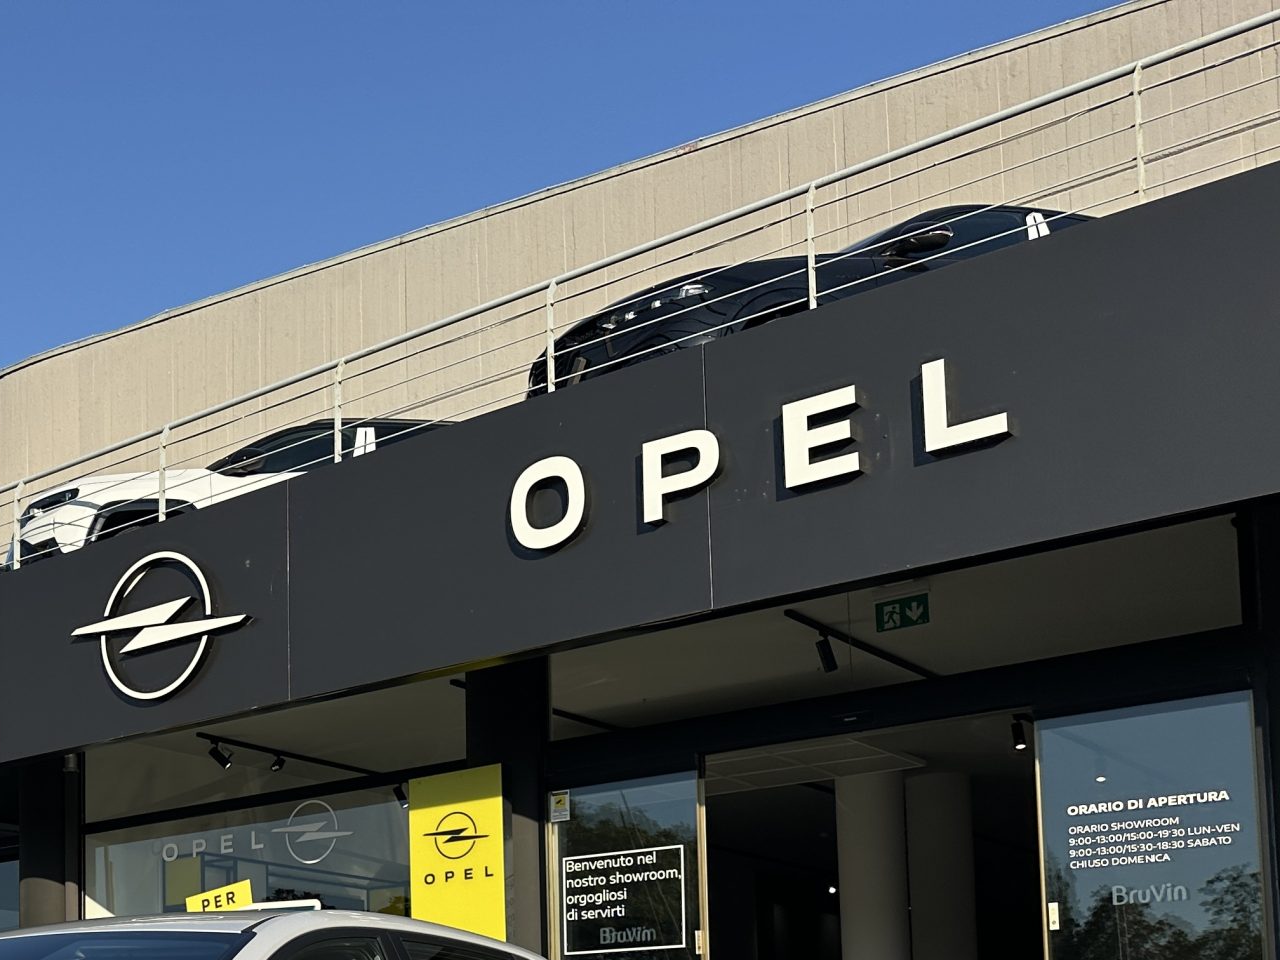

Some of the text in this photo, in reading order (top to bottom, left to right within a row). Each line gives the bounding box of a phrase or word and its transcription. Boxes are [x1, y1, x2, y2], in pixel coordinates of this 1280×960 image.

[510, 358, 1008, 549] OPEL
[1067, 790, 1229, 816] ORARIO DI APERTURA
[1068, 817, 1180, 835] ORARIO SHOWROOM
[1187, 823, 1240, 836] LUN-VEN
[162, 831, 264, 862] OPEL
[1187, 836, 1232, 848] SABATO
[566, 851, 656, 873] Benvenuto nel
[1070, 853, 1171, 869] CHIUSO DOMENICA
[424, 866, 494, 885] OPEL
[566, 868, 682, 888] nostro showroom,
[202, 891, 236, 912] PER
[566, 888, 627, 906] orgogliosi
[1111, 883, 1188, 906] BruVin
[567, 905, 625, 921] di servirti
